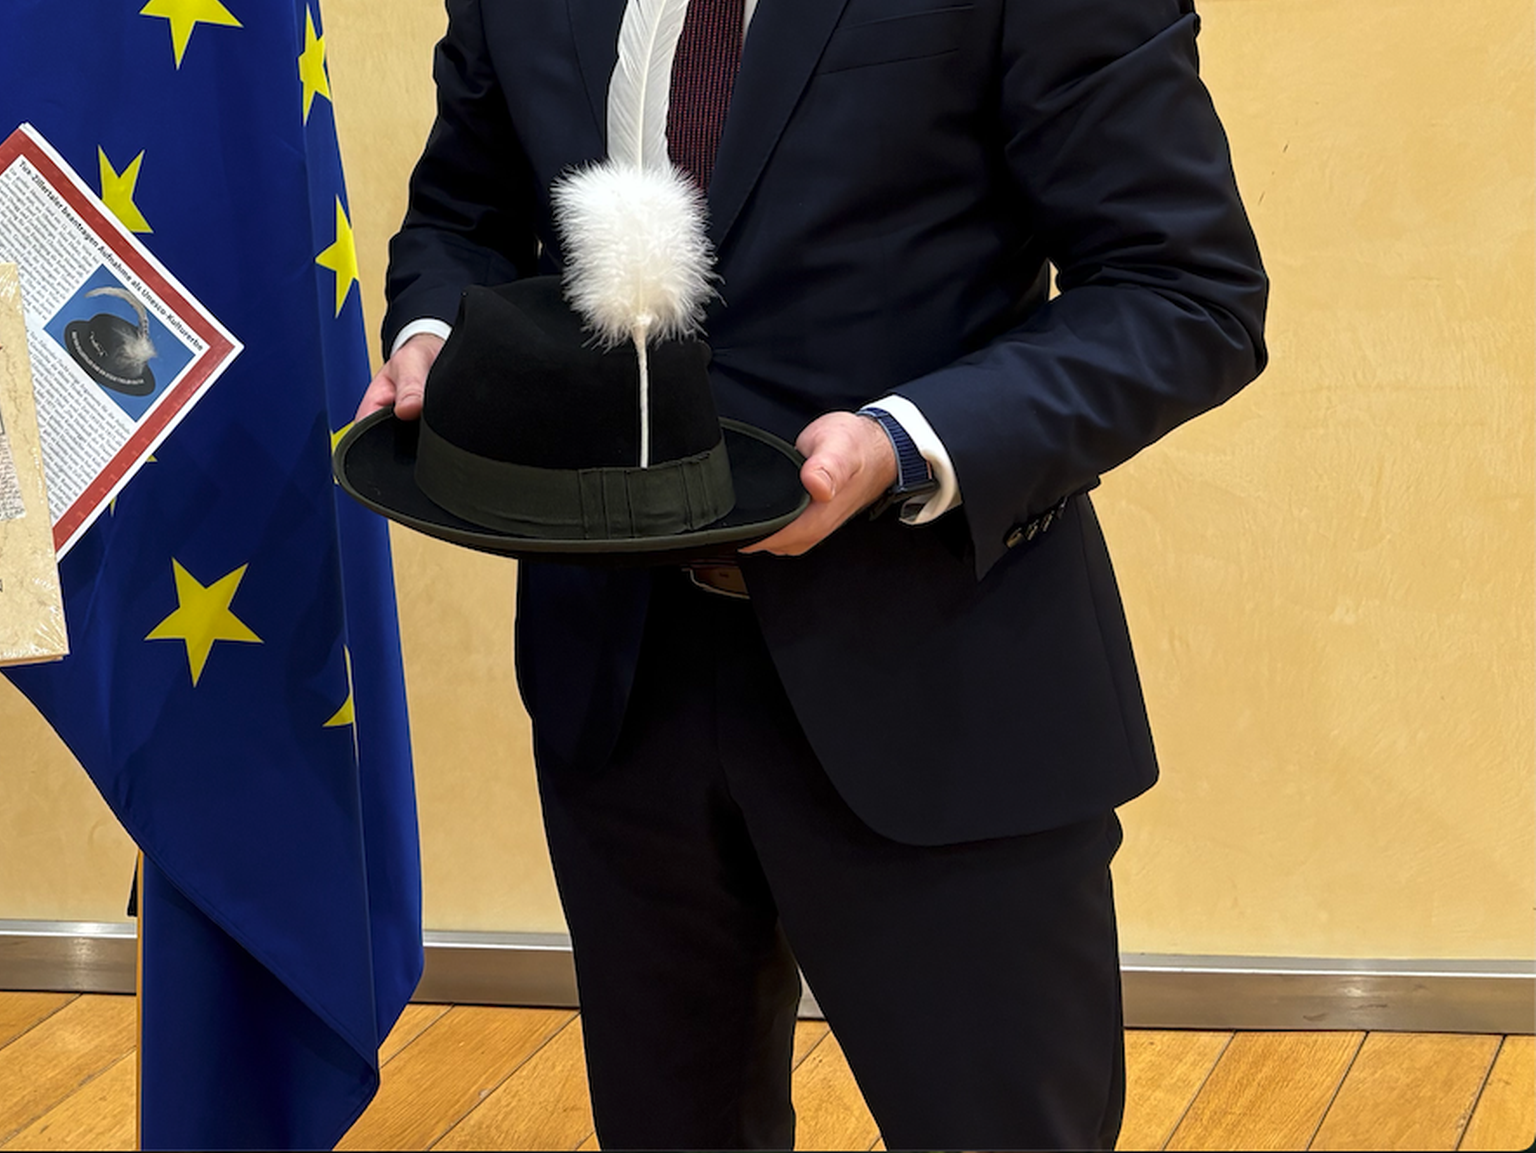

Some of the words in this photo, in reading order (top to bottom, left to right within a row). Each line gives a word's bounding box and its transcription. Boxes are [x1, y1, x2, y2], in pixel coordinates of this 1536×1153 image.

[61, 206, 100, 249] beantragen
[96, 243, 133, 282] Aufnahme
[129, 277, 144, 292] als
